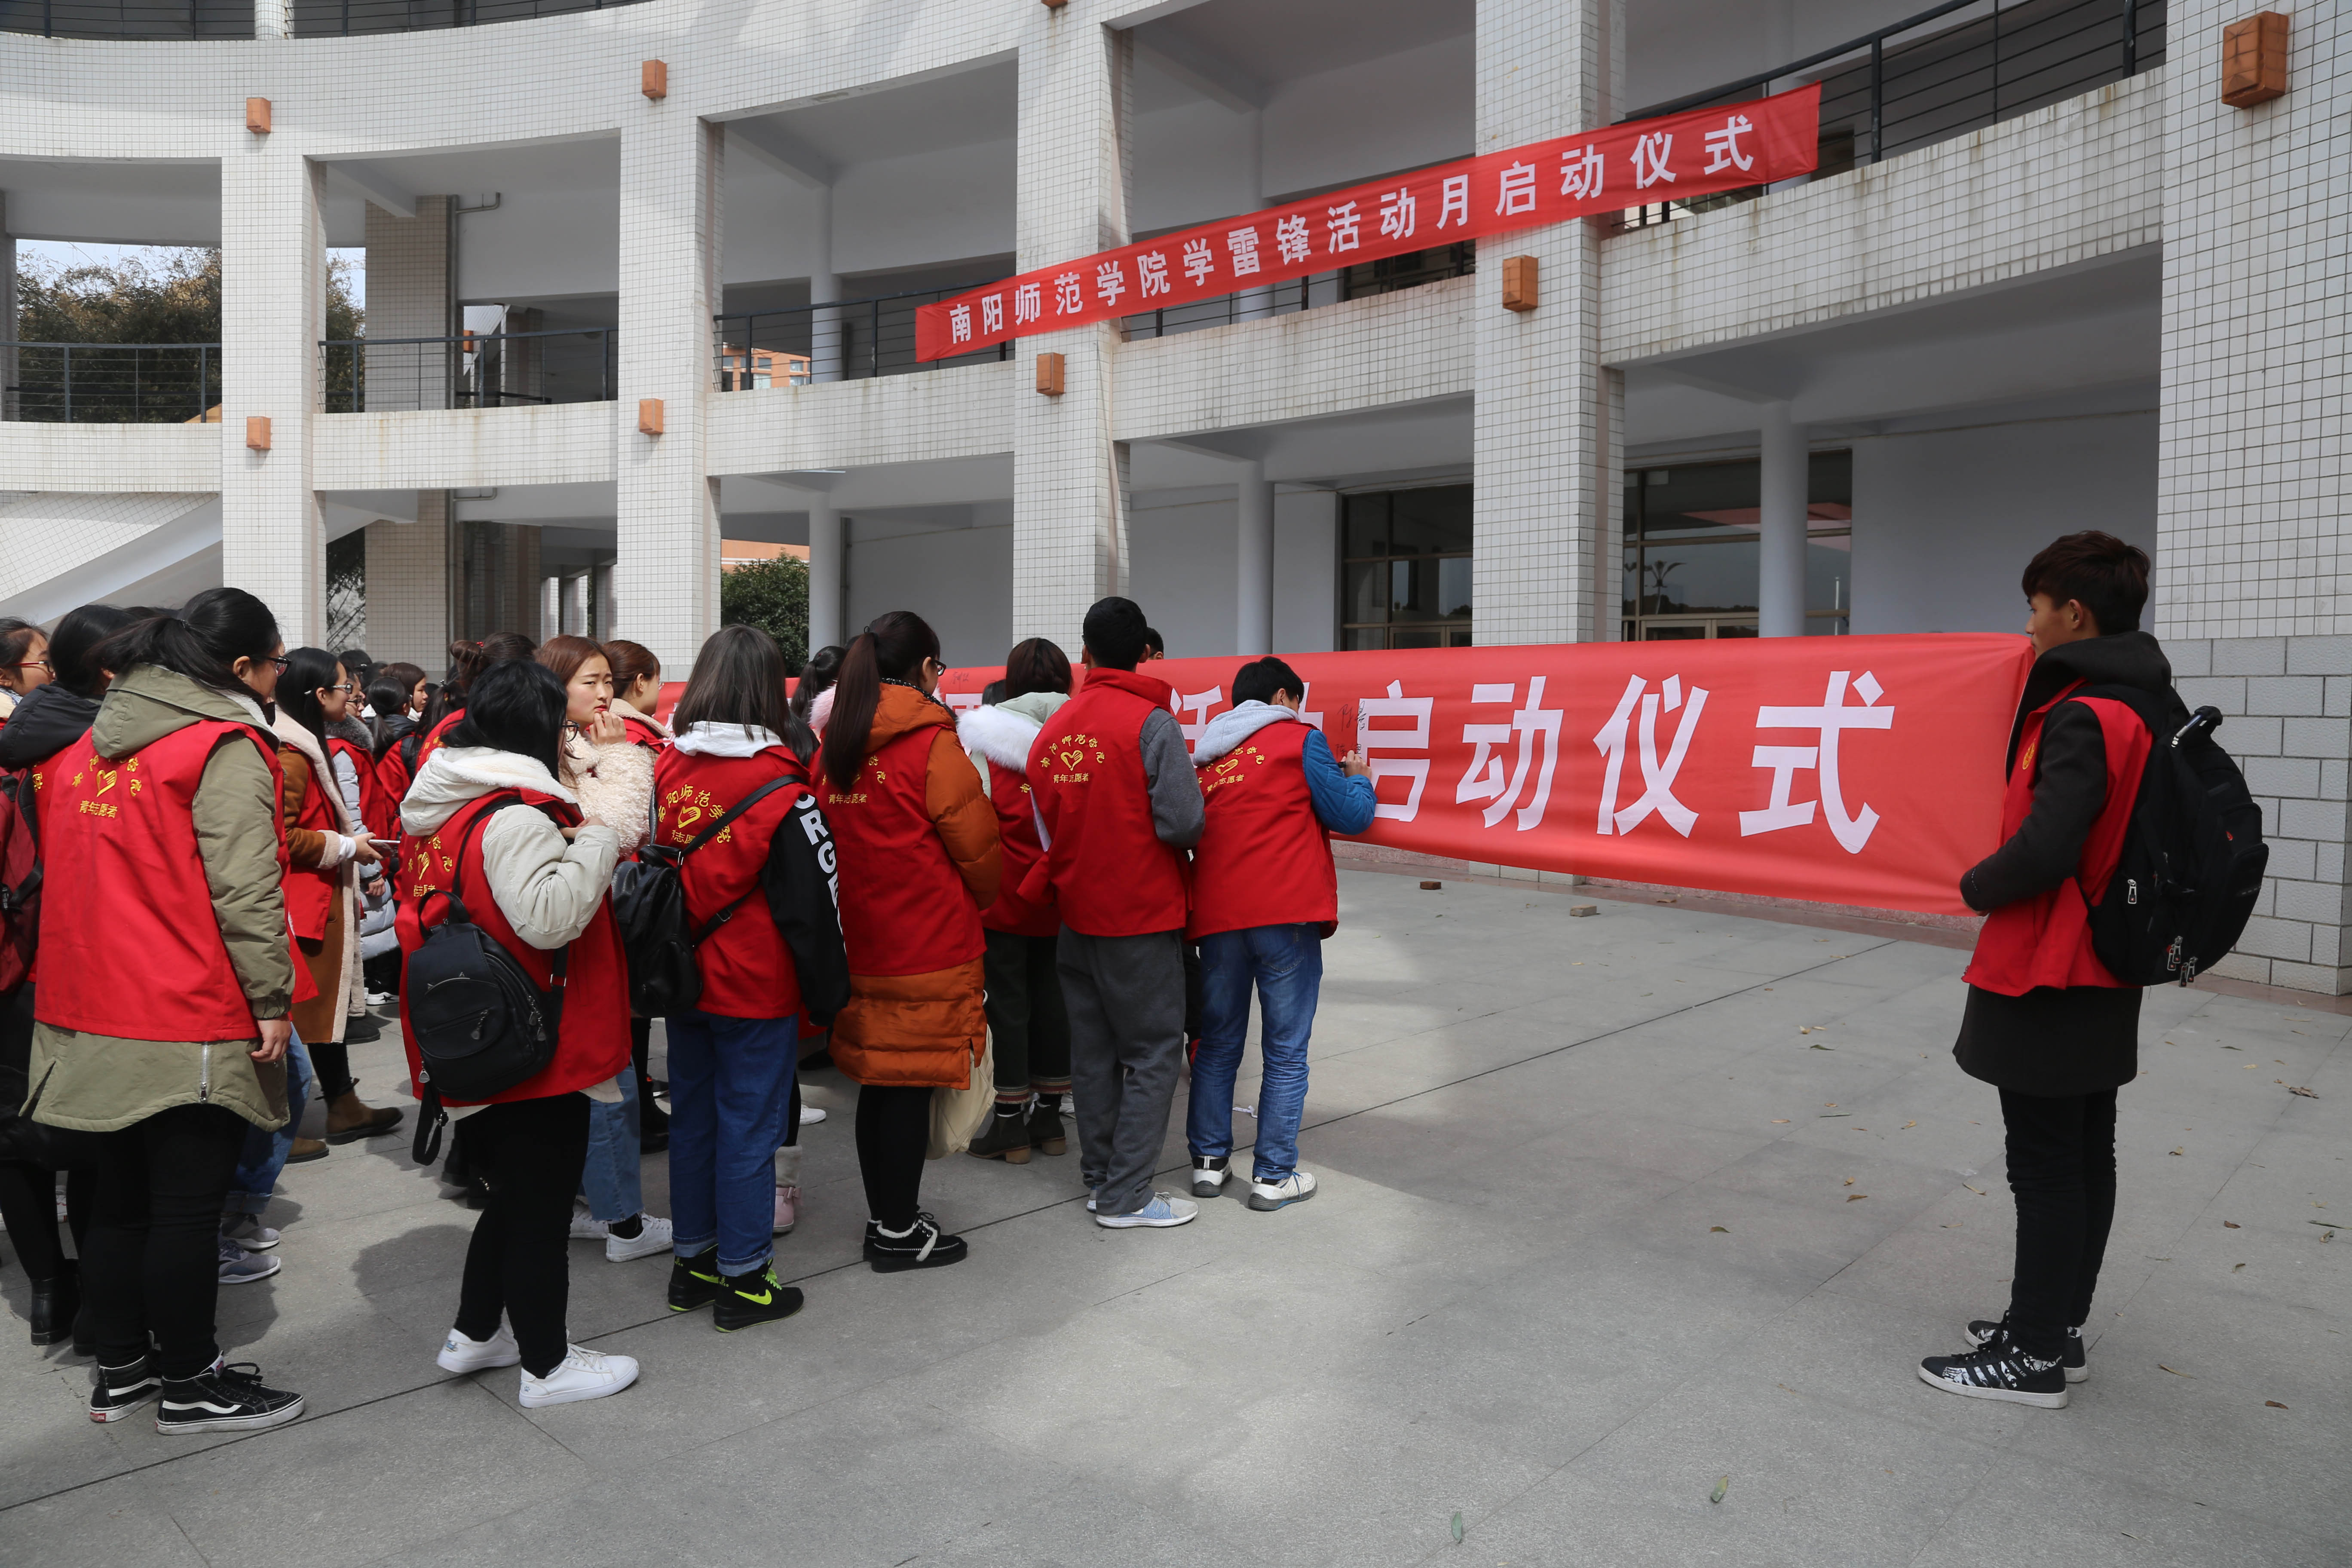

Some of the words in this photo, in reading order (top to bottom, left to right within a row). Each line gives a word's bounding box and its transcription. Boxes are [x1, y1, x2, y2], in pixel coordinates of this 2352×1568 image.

[950, 115, 1753, 343] 南阳师范学院学雷锋活动月启动仪式
